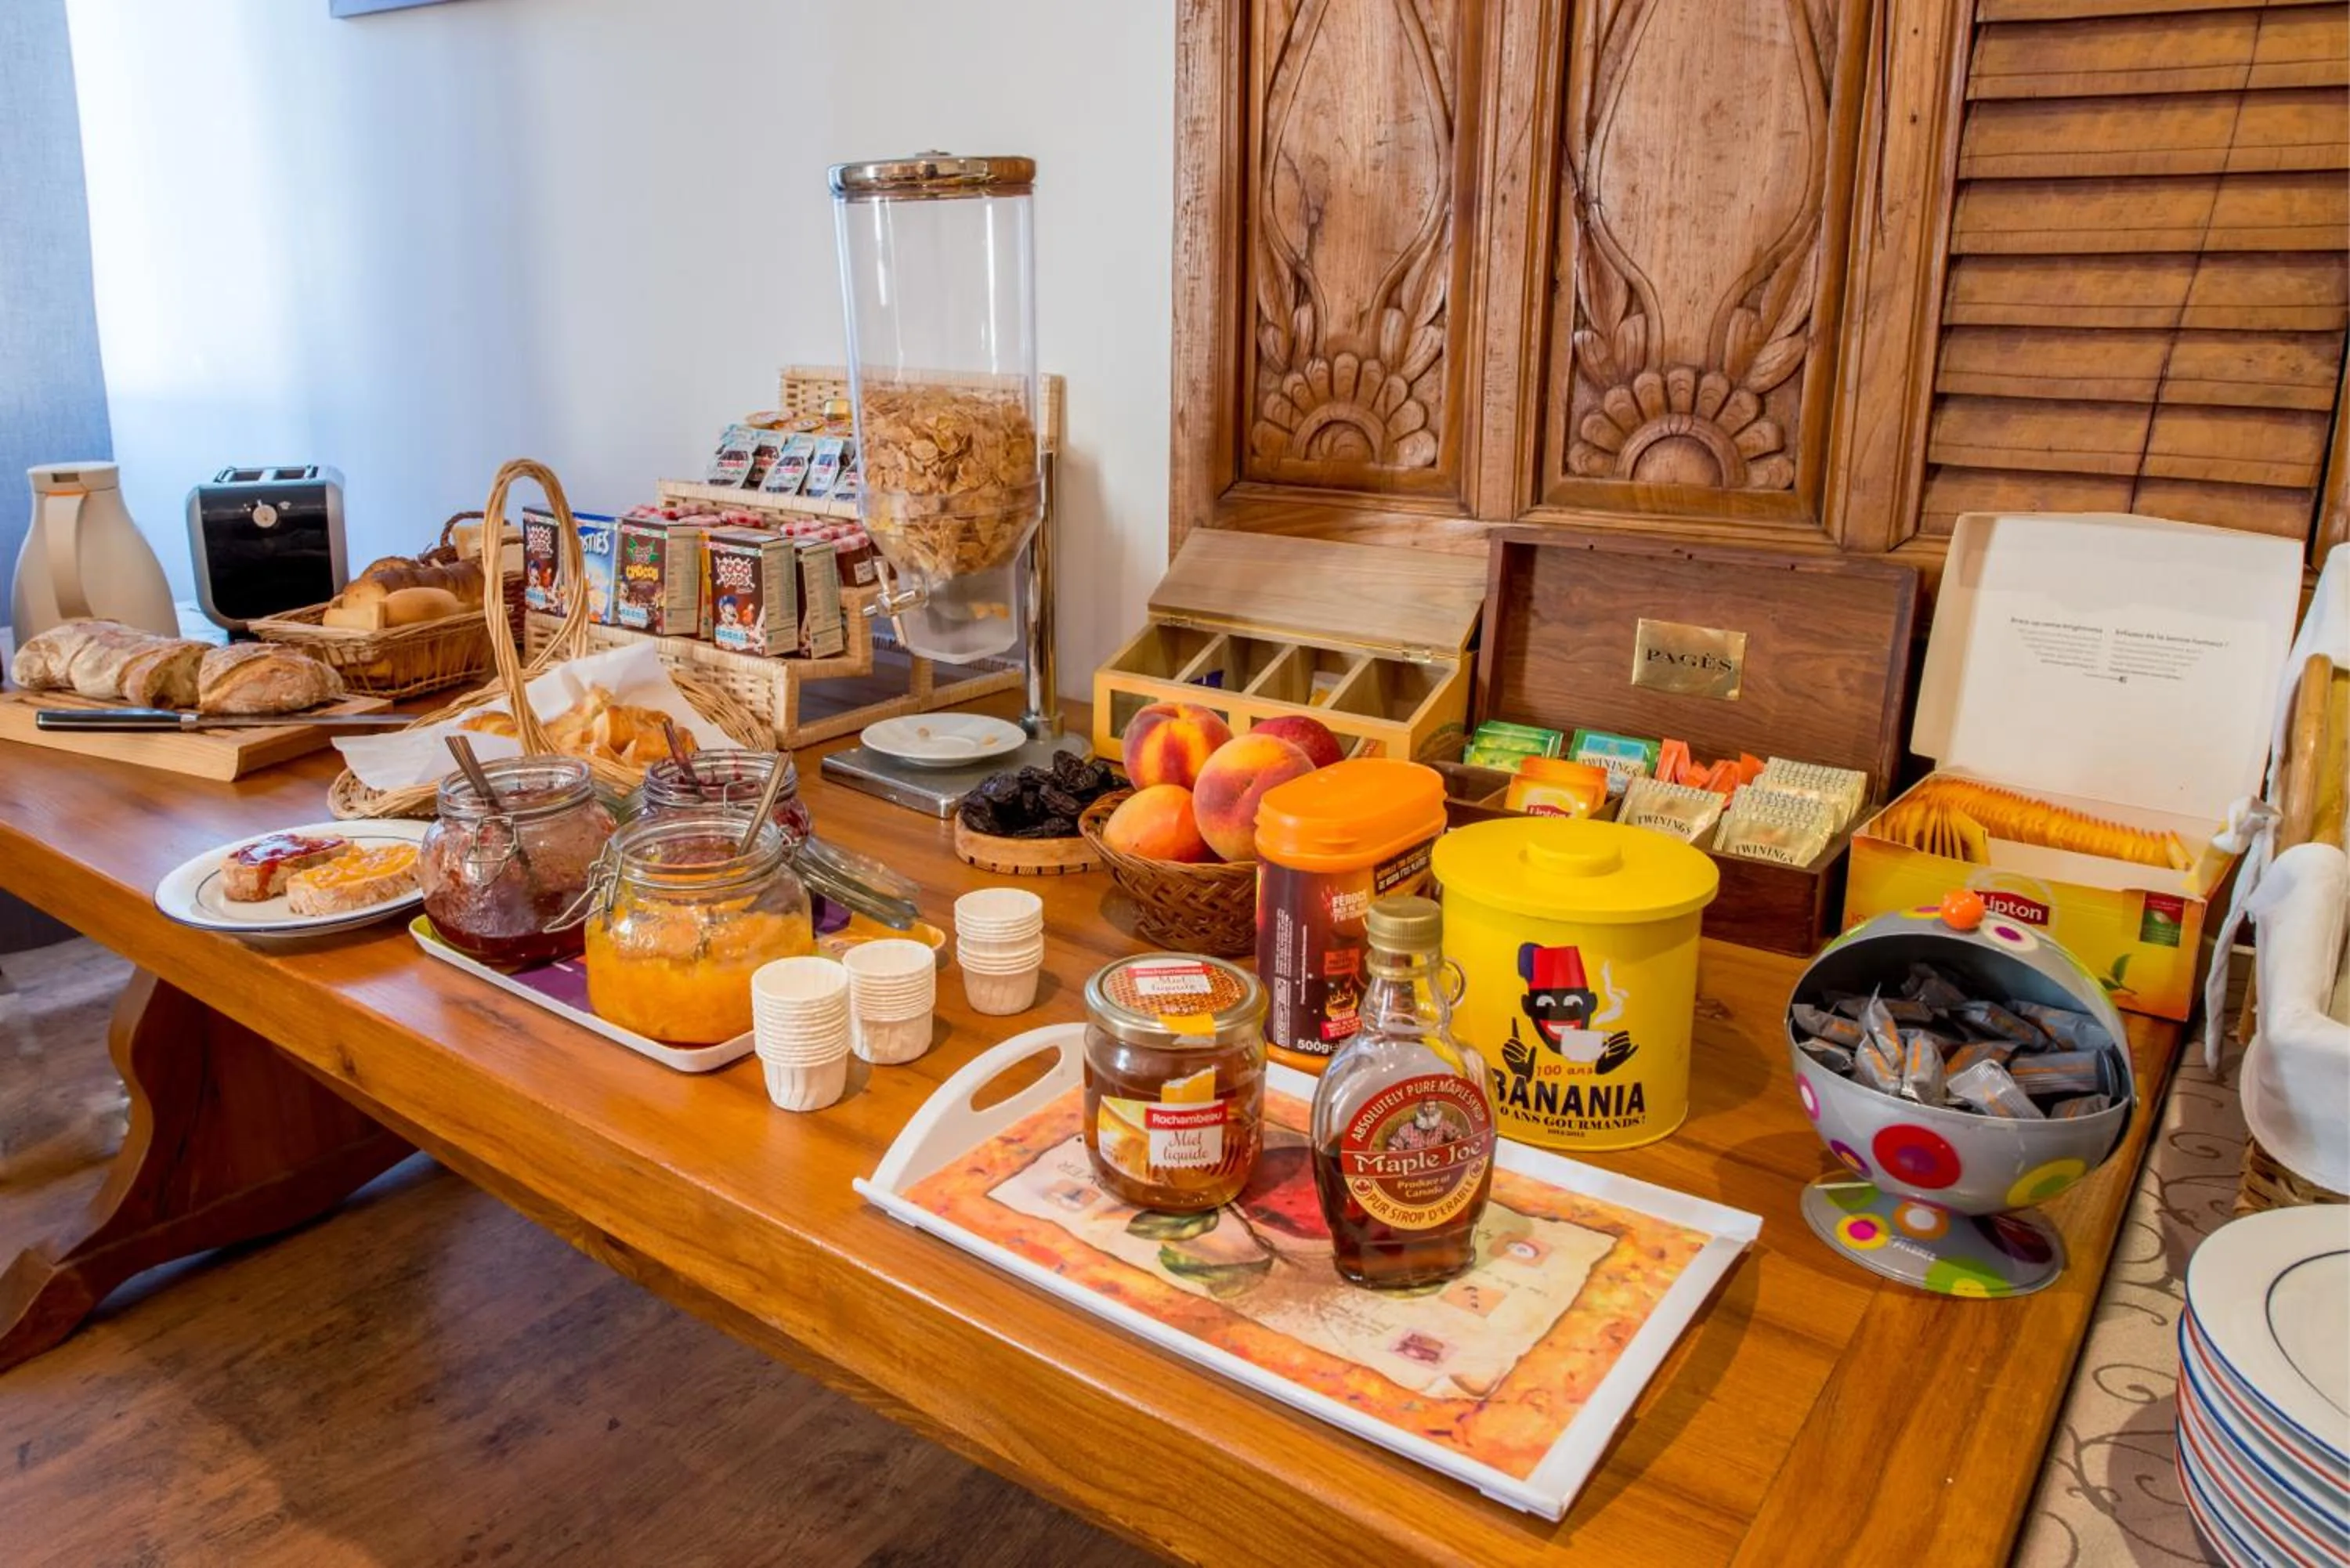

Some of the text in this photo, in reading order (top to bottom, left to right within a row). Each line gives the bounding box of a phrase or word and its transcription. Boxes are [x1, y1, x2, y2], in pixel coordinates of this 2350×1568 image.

[1647, 649, 1732, 671] PAGÈS
[1636, 814, 1693, 835] TWININGS
[1981, 894, 2042, 921] Lipton
[1297, 1039, 1330, 1054] 500g
[1491, 1068, 1646, 1118] BANANIA
[1152, 1110, 1223, 1125] Rochambeau
[1351, 1088, 1405, 1143] ABSOLUTELY
[1407, 1080, 1437, 1095] PURE
[1513, 1109, 1541, 1124] ANS
[1168, 1130, 1203, 1147] Miel
[1163, 1146, 1209, 1164] liquide
[1354, 1142, 1481, 1176] Maple Joe
[1366, 1194, 1390, 1214] PUR
[1390, 1209, 1426, 1223] SIROP
